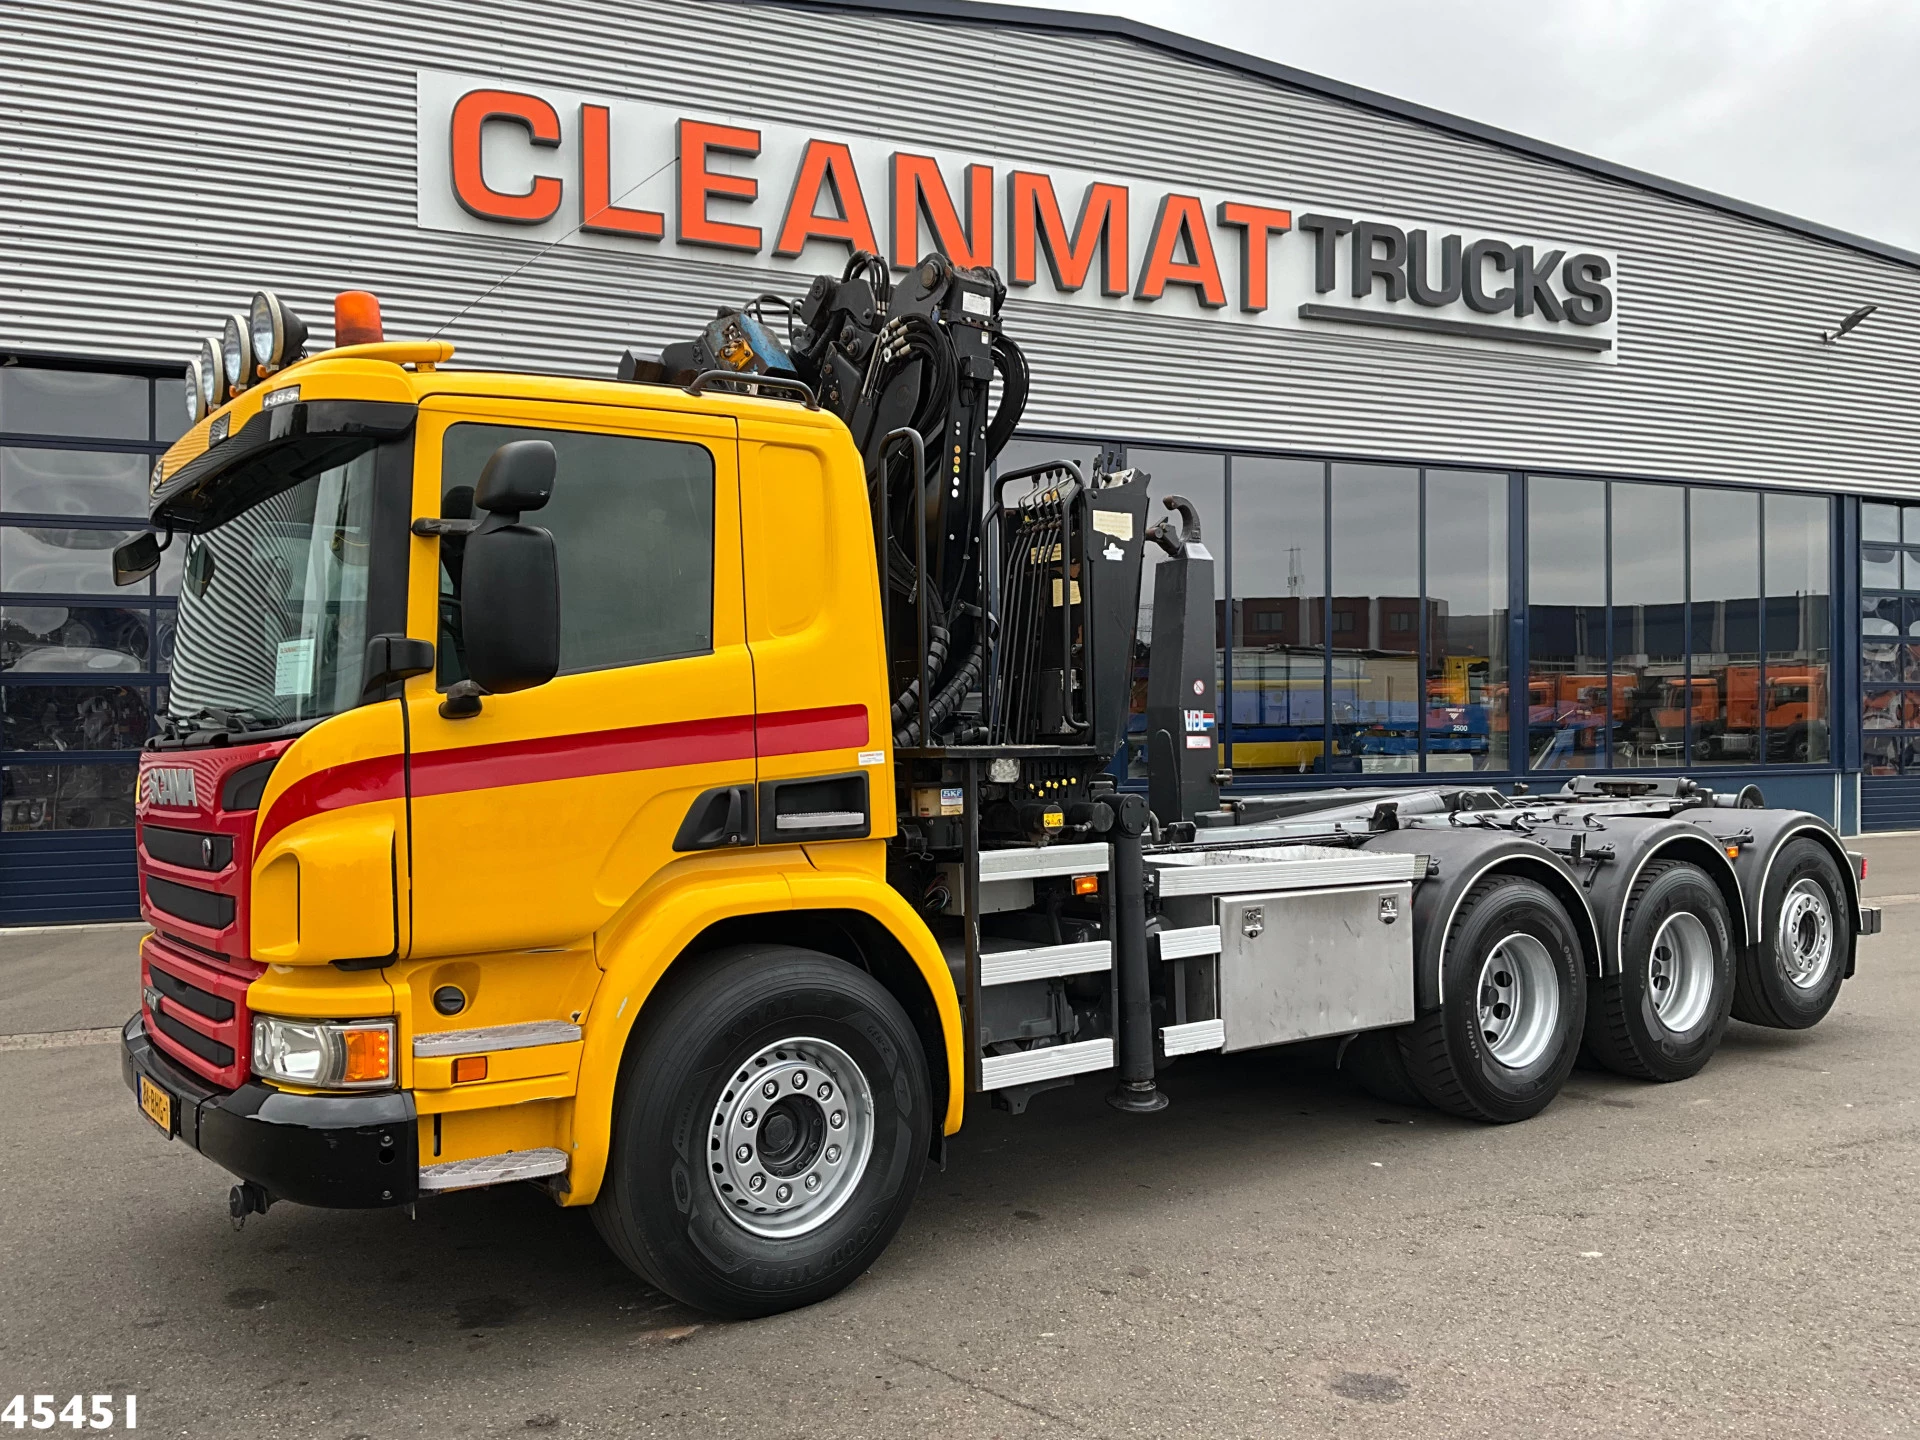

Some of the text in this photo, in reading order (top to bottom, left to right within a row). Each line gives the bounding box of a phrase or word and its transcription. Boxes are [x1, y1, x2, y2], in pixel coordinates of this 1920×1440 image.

[449, 88, 1611, 325] CLEANMAT TRUCKS
[1184, 709, 1207, 731] VDL
[149, 767, 198, 807] SCANIA
